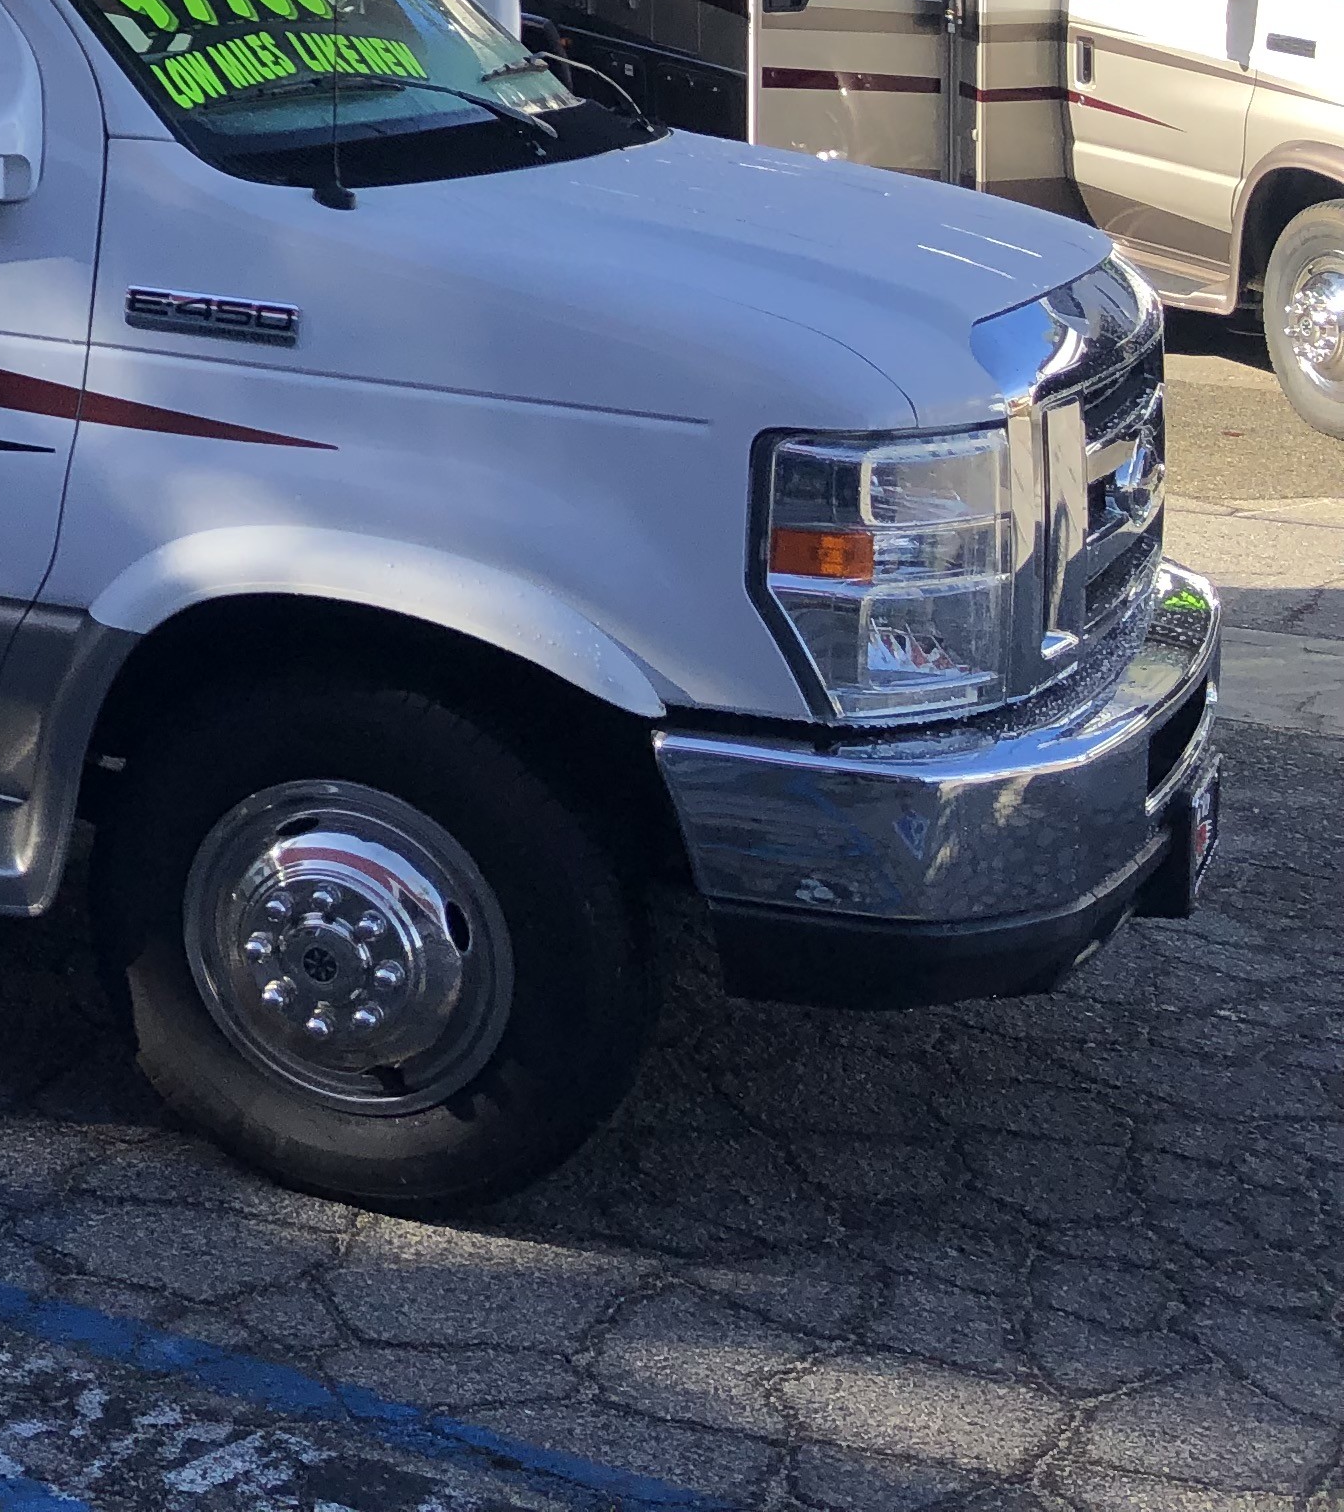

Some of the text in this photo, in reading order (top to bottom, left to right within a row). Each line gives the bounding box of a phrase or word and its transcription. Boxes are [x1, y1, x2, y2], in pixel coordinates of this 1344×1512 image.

[149, 31, 429, 110] LOW MILES LIKE NEW
